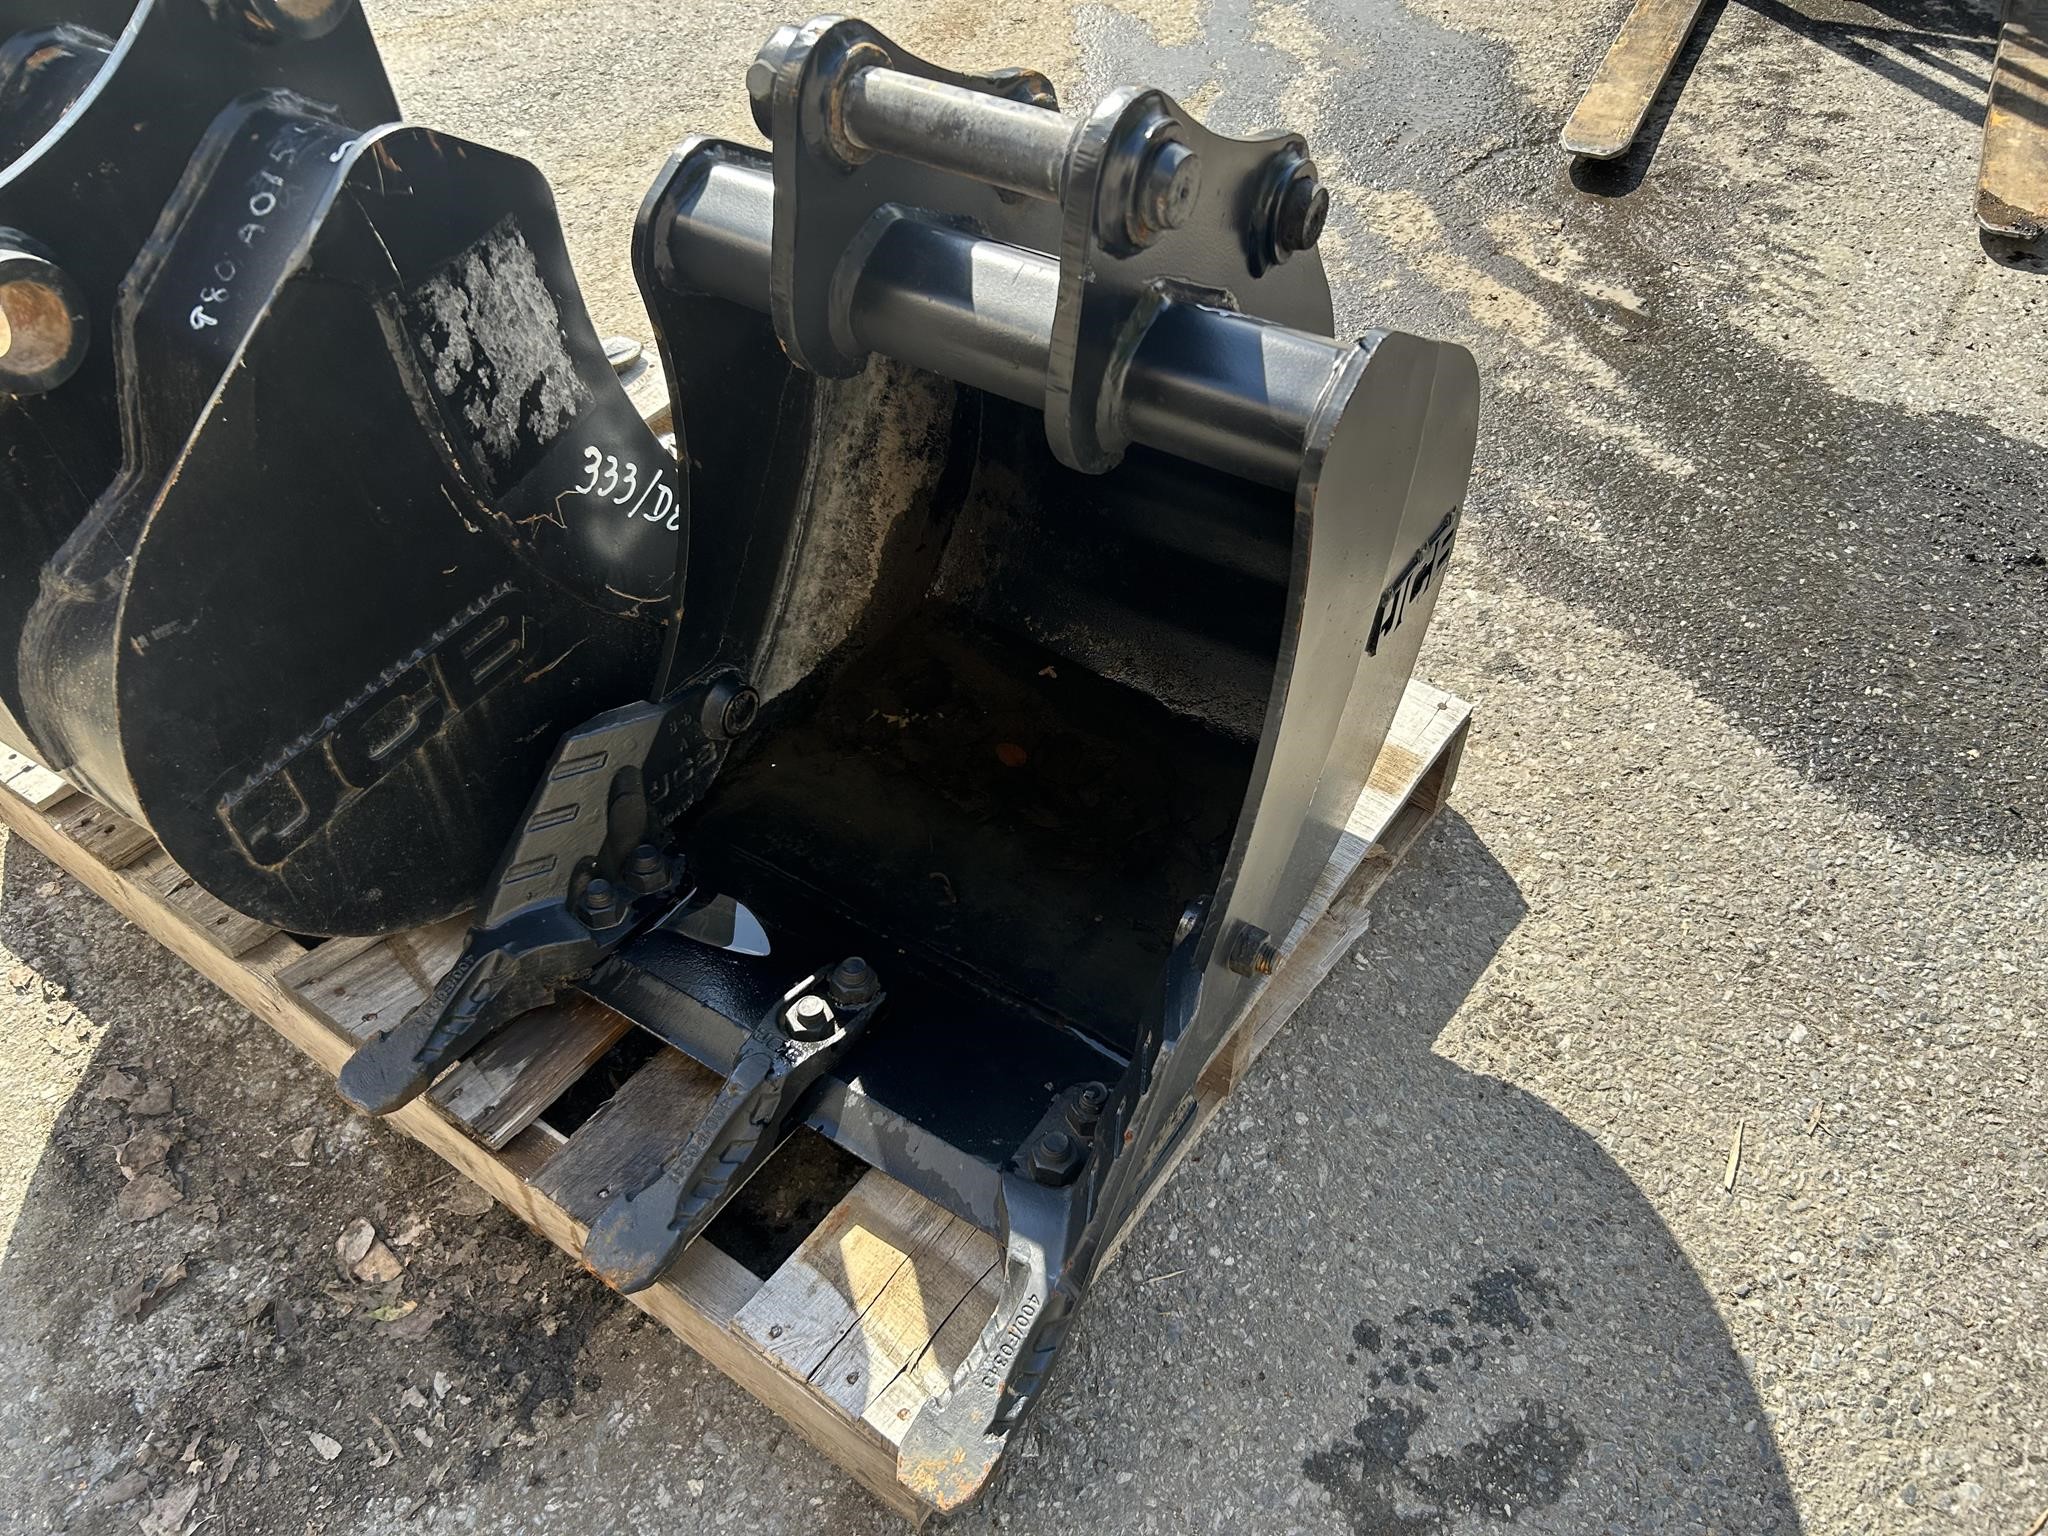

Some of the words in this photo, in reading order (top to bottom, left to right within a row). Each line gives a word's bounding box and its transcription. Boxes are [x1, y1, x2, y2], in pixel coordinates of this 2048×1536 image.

[1364, 504, 1458, 658] JCB
[216, 580, 538, 874] JCB
[982, 1293, 1040, 1388] 400/F0343
